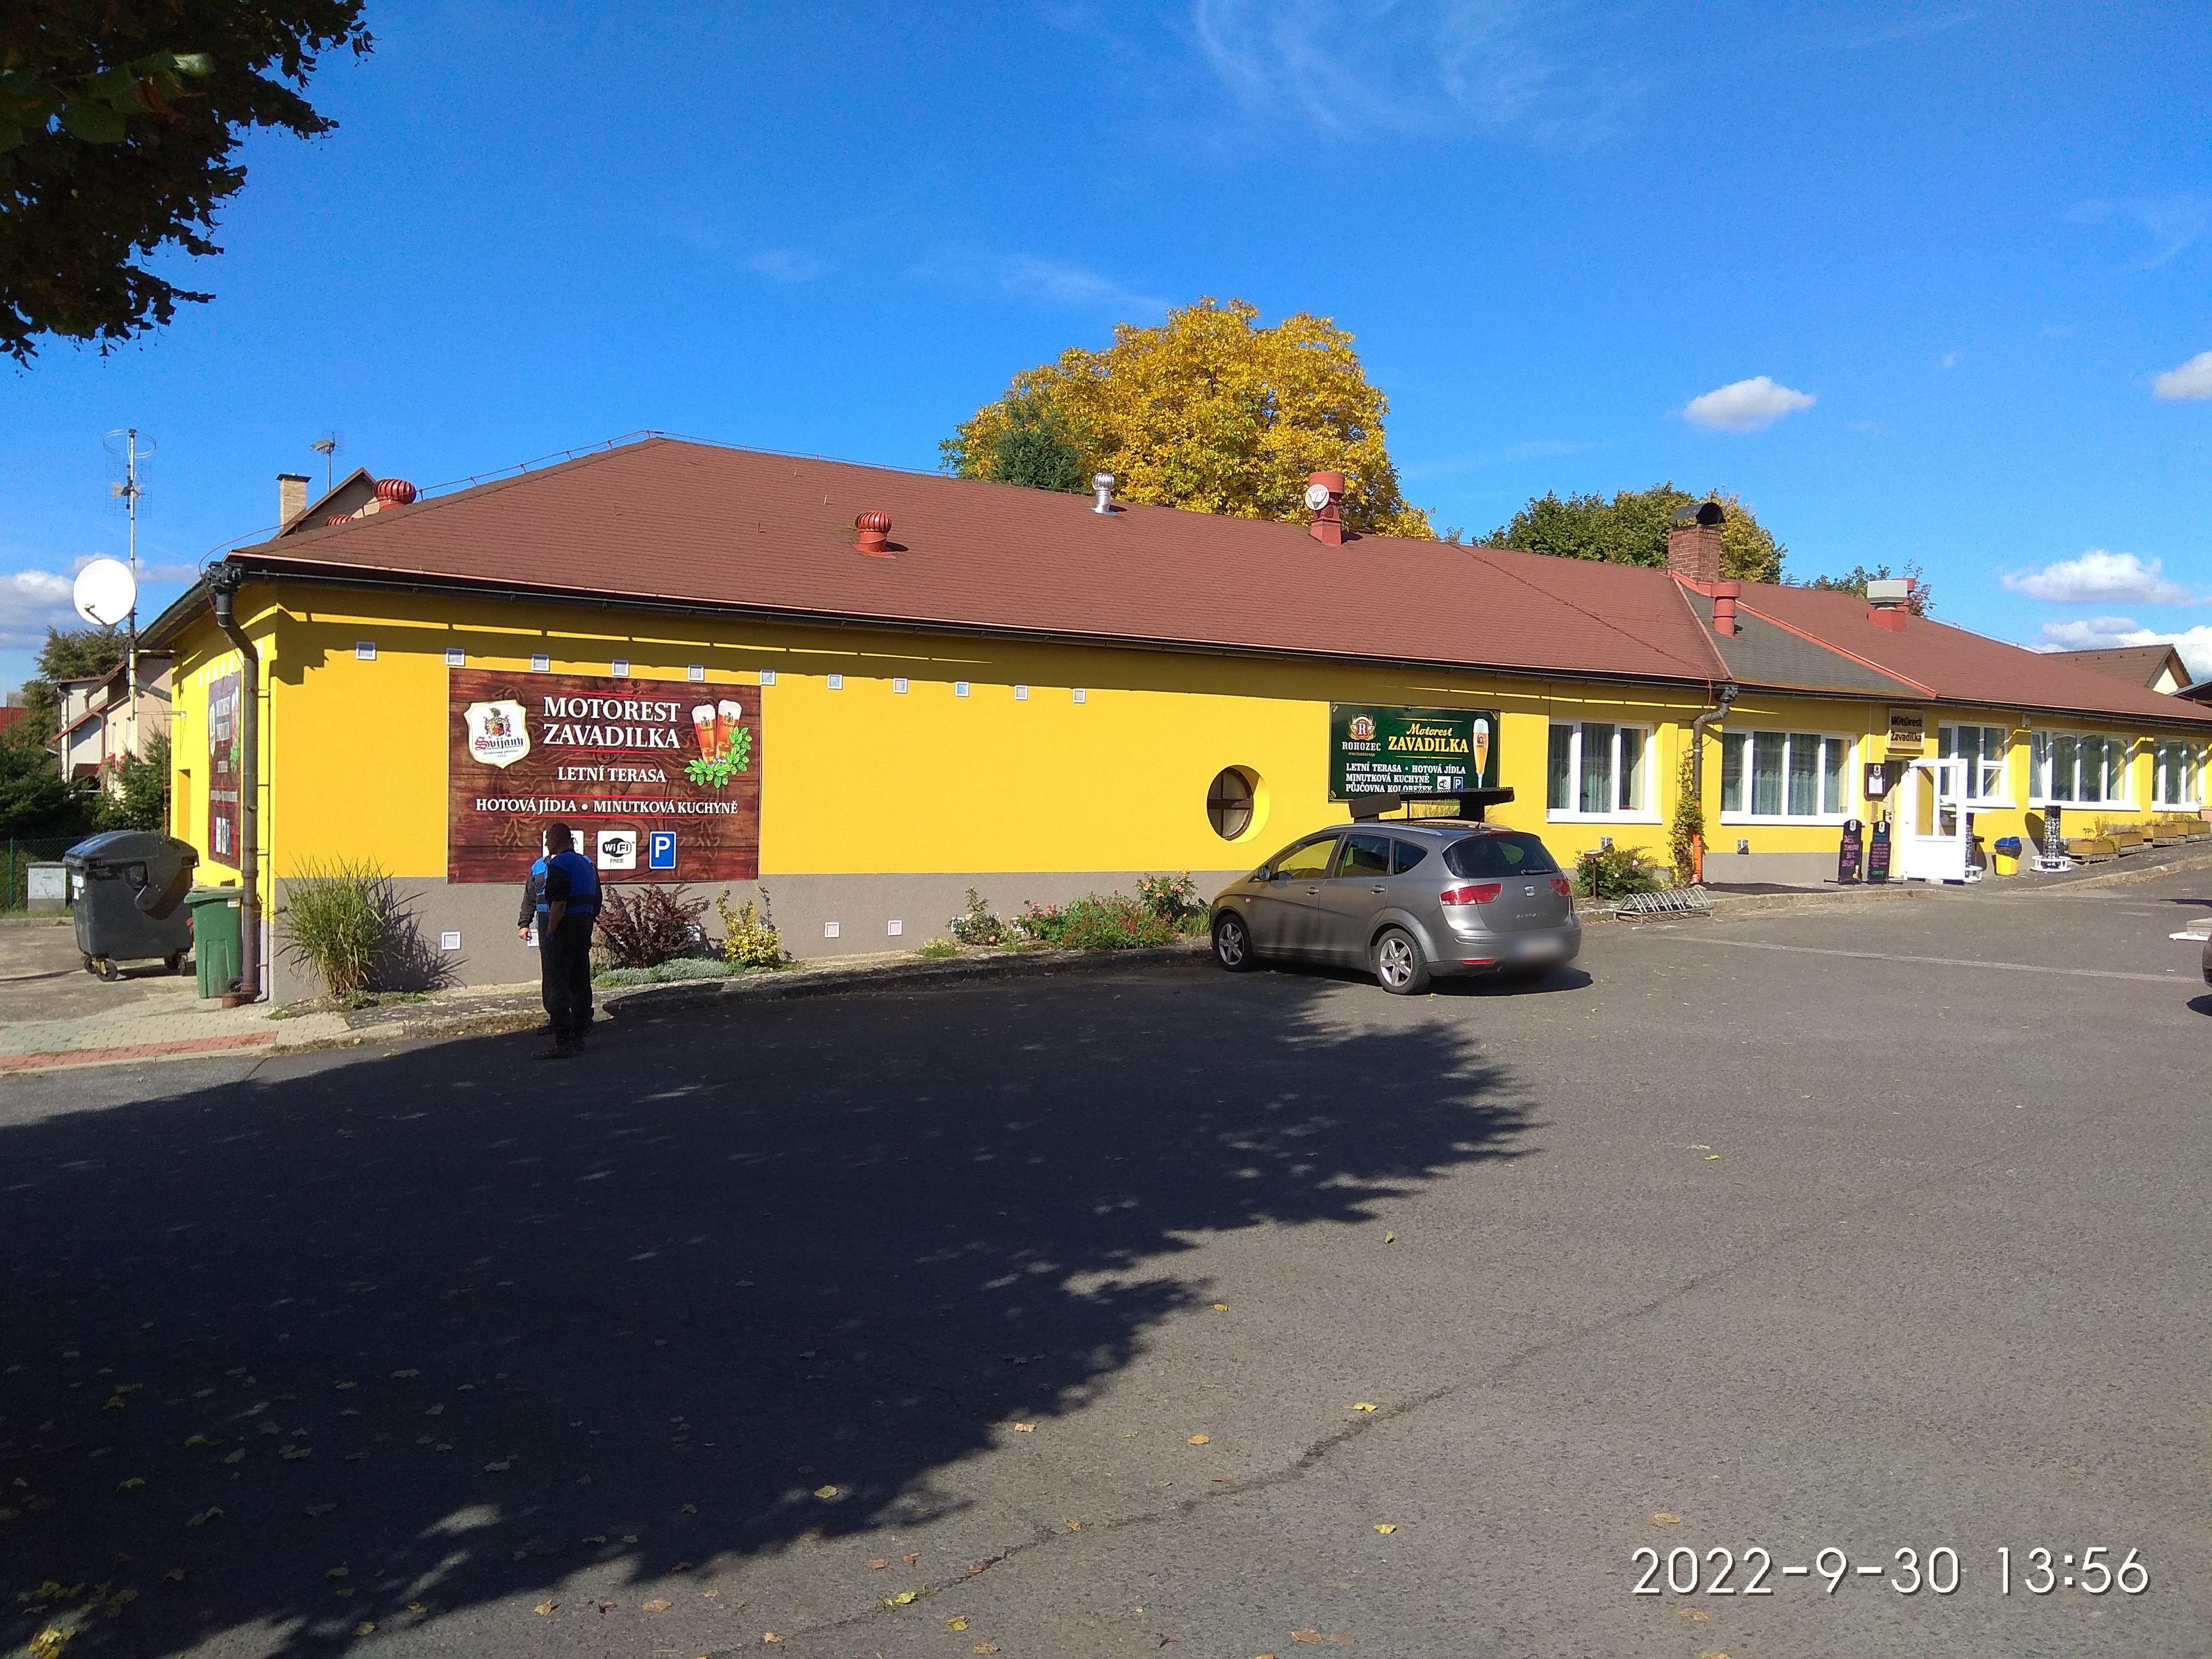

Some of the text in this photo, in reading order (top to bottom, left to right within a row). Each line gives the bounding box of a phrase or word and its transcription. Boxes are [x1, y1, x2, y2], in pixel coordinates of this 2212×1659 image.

[543, 696, 681, 722] MOTOREST
[543, 723, 681, 749] ZAVADILKA
[1358, 723, 1366, 735] R
[1406, 723, 1453, 737] Motorest
[475, 737, 523, 751] Svijany
[1342, 741, 1381, 752] ROHOZEC
[1388, 736, 1469, 753] ZAVADILKA
[557, 765, 666, 783] LETNÍ TERASA
[1346, 761, 1466, 774] LETNÍ TERASA HOTOVÁ JÍDLA
[1345, 772, 1430, 784] MINUTKOVÁ KUCHYNĚ
[1345, 781, 1385, 792] PŮJČOVNA
[476, 797, 738, 815] HOTOVÁ JÍDLA MINUTKOVÁ KUCHYNĚ
[655, 836, 670, 858] P
